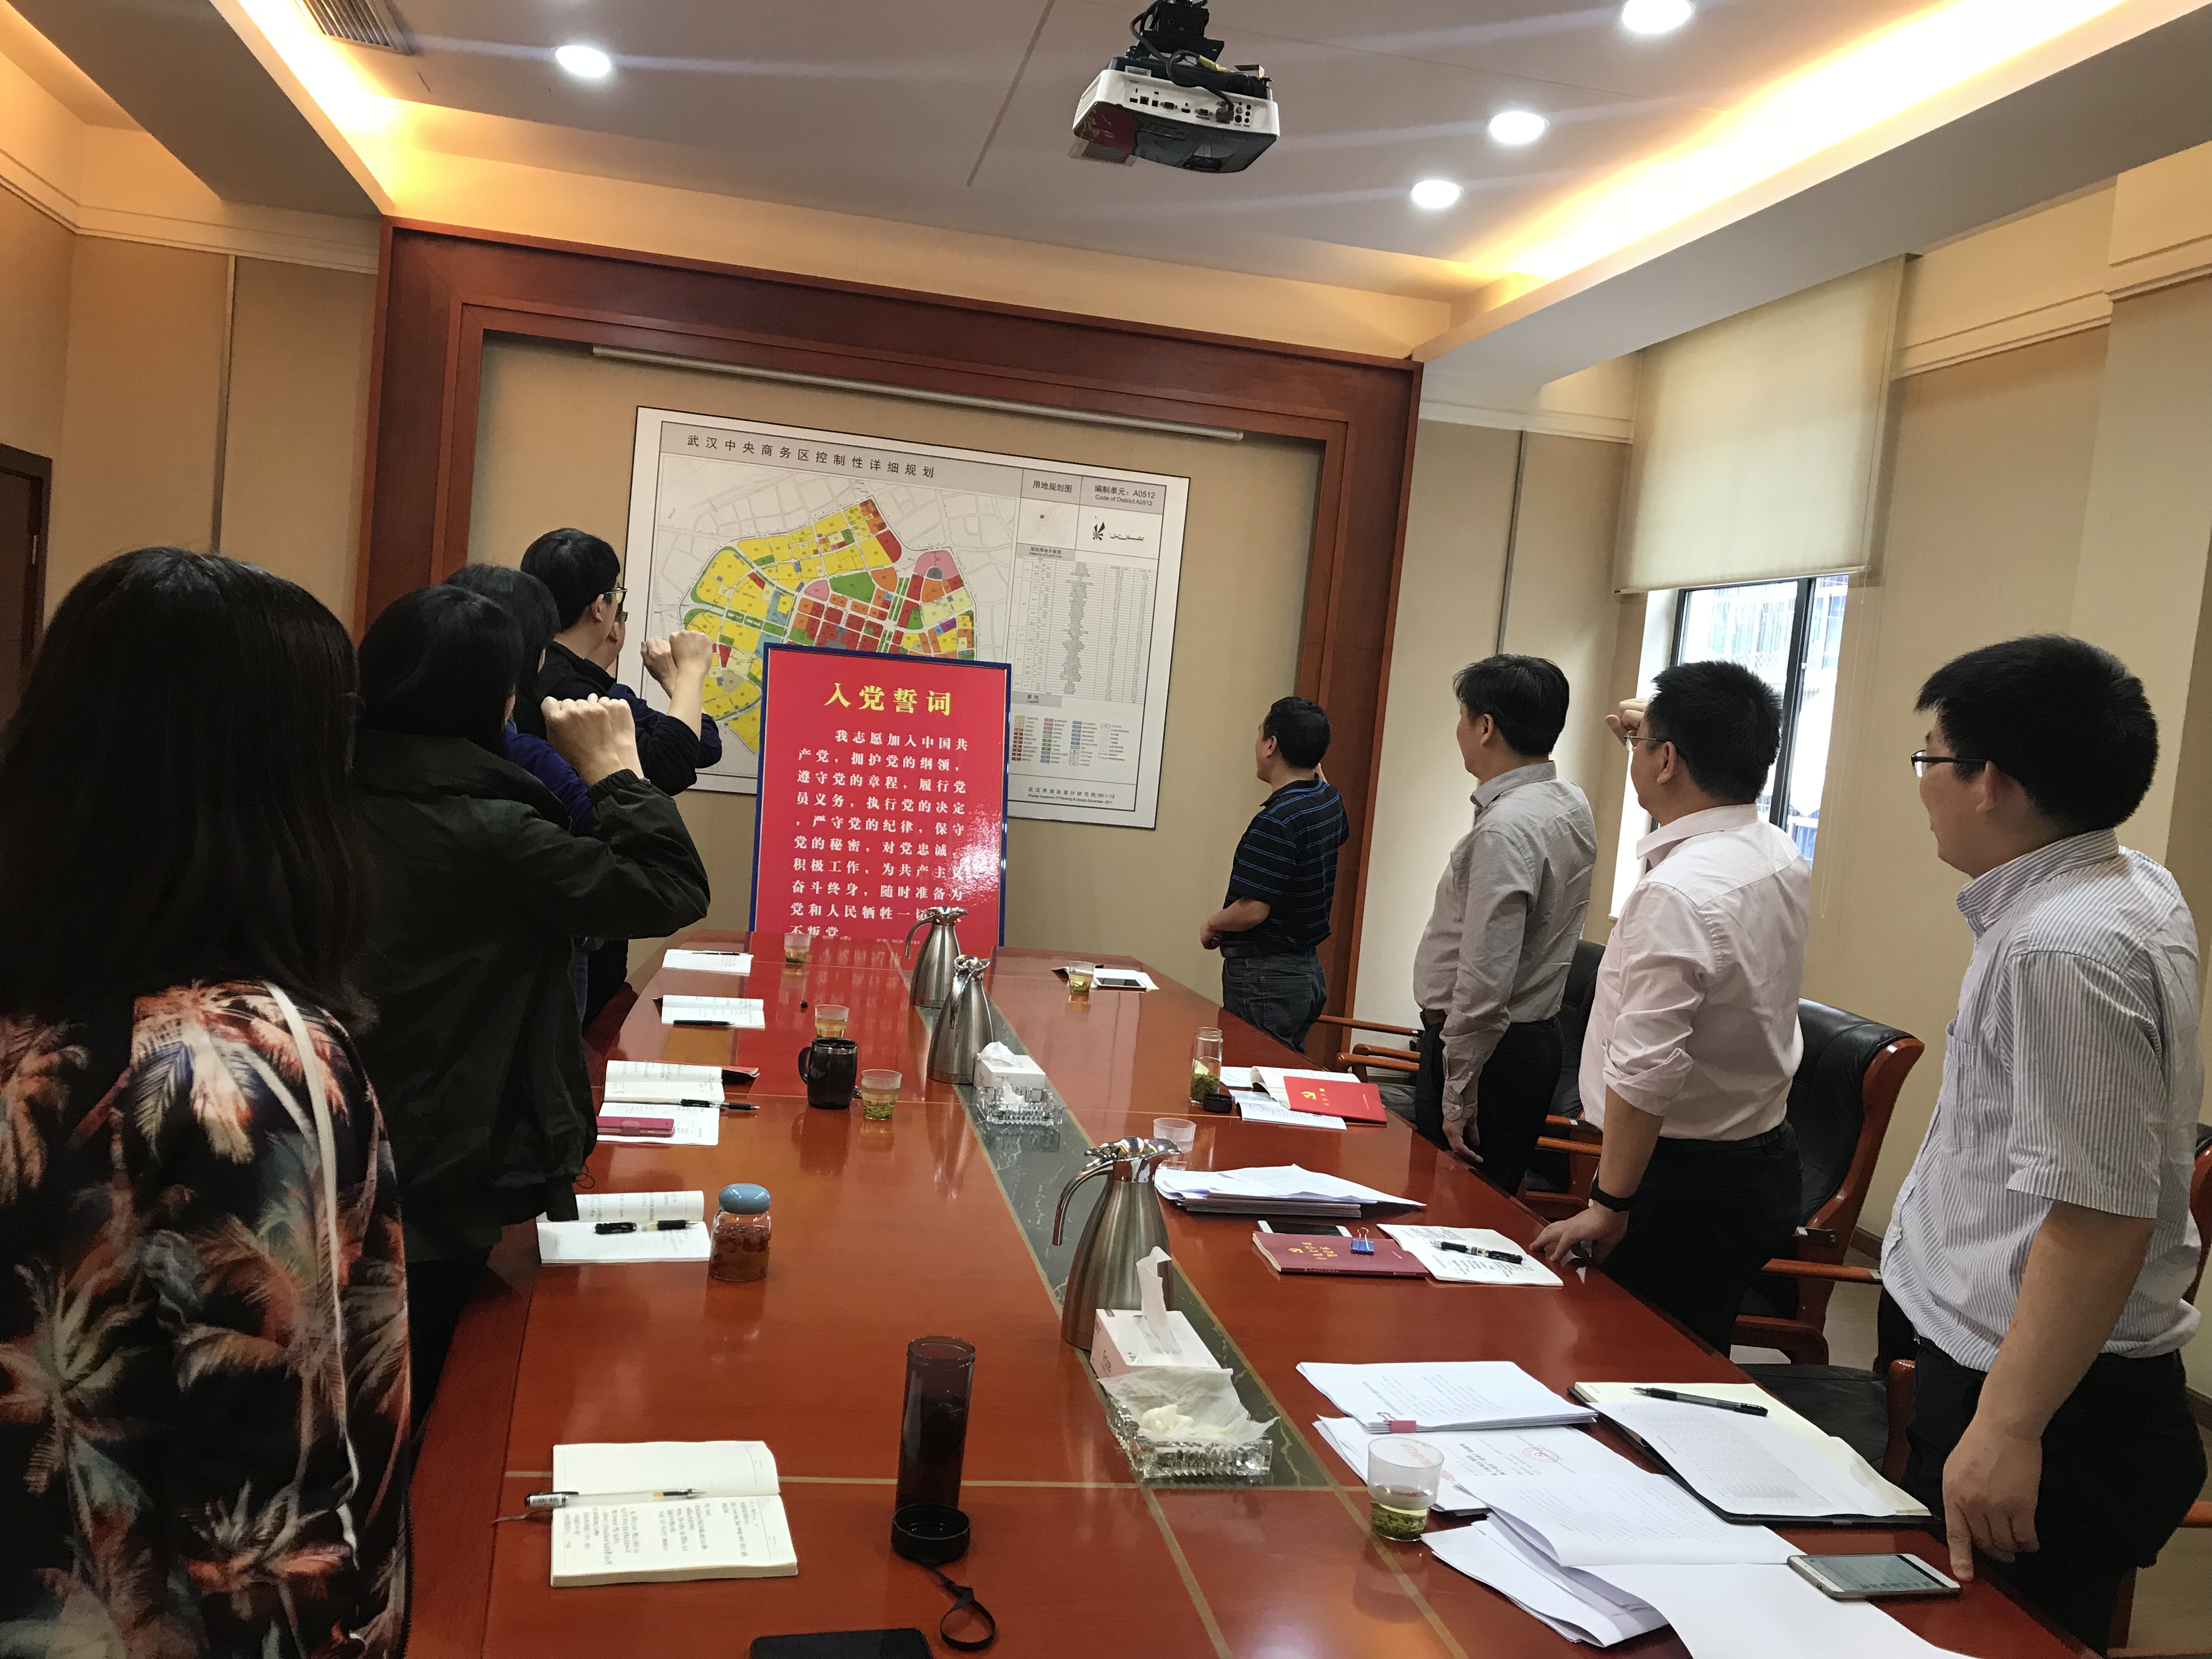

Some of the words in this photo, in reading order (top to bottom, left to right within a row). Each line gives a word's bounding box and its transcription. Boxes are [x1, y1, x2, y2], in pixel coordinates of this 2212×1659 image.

[687, 435, 934, 478] 武汉中央商务区控制性详细规划
[1032, 481, 1072, 493] 用地规划图
[824, 682, 951, 715] 入党誓词
[836, 730, 967, 751] 我志愿加入中国共
[798, 748, 959, 771] 产党，拥护党的纲领，
[797, 770, 966, 793] 遵守党的章程，履行党
[797, 792, 965, 815] 员义务，执行党的决定
[792, 880, 962, 901] 奋斗终身，随时准备为
[791, 902, 962, 923] 党和人民牺牲一切
